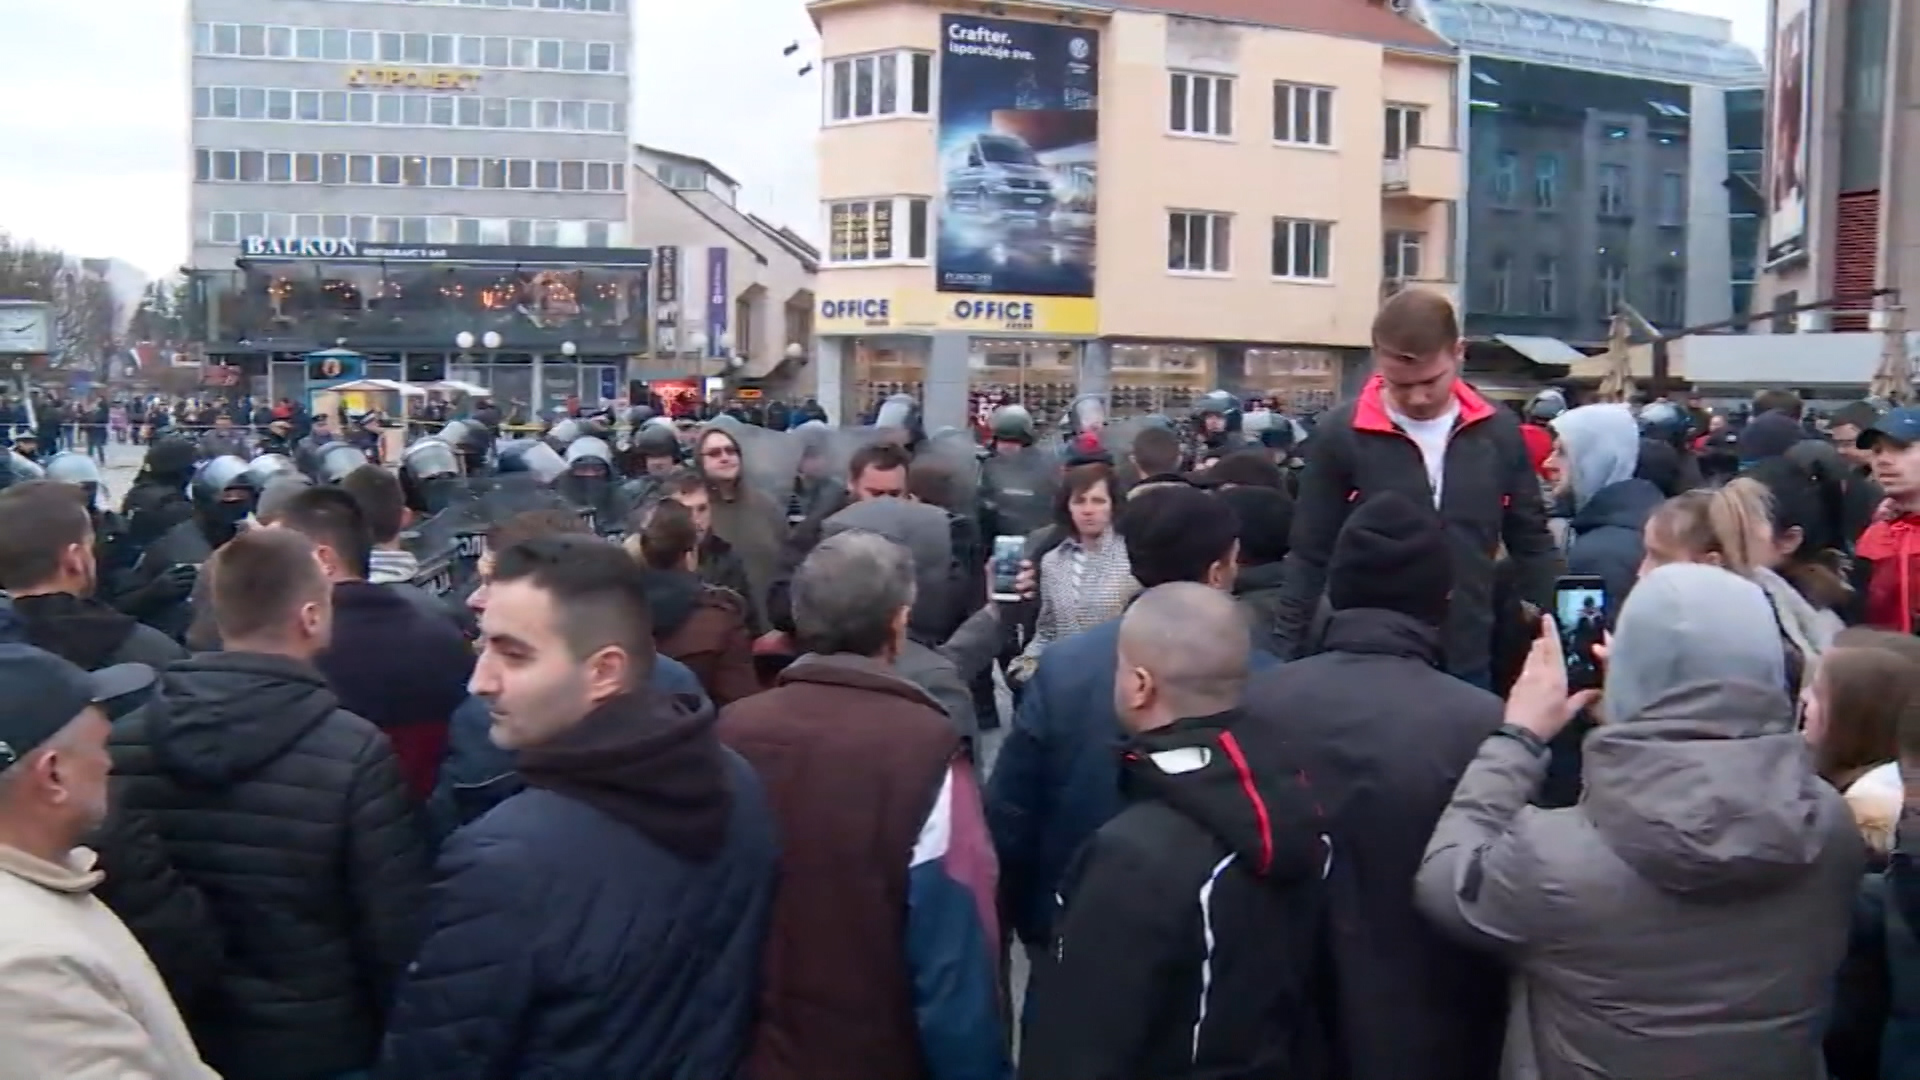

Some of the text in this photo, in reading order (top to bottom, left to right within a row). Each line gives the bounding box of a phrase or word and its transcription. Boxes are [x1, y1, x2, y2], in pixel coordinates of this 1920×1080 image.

[948, 23, 1013, 45] Crafter.
[246, 235, 358, 256] BALKON
[821, 299, 889, 318] OFFICE
[954, 299, 1034, 320] OFFICE
